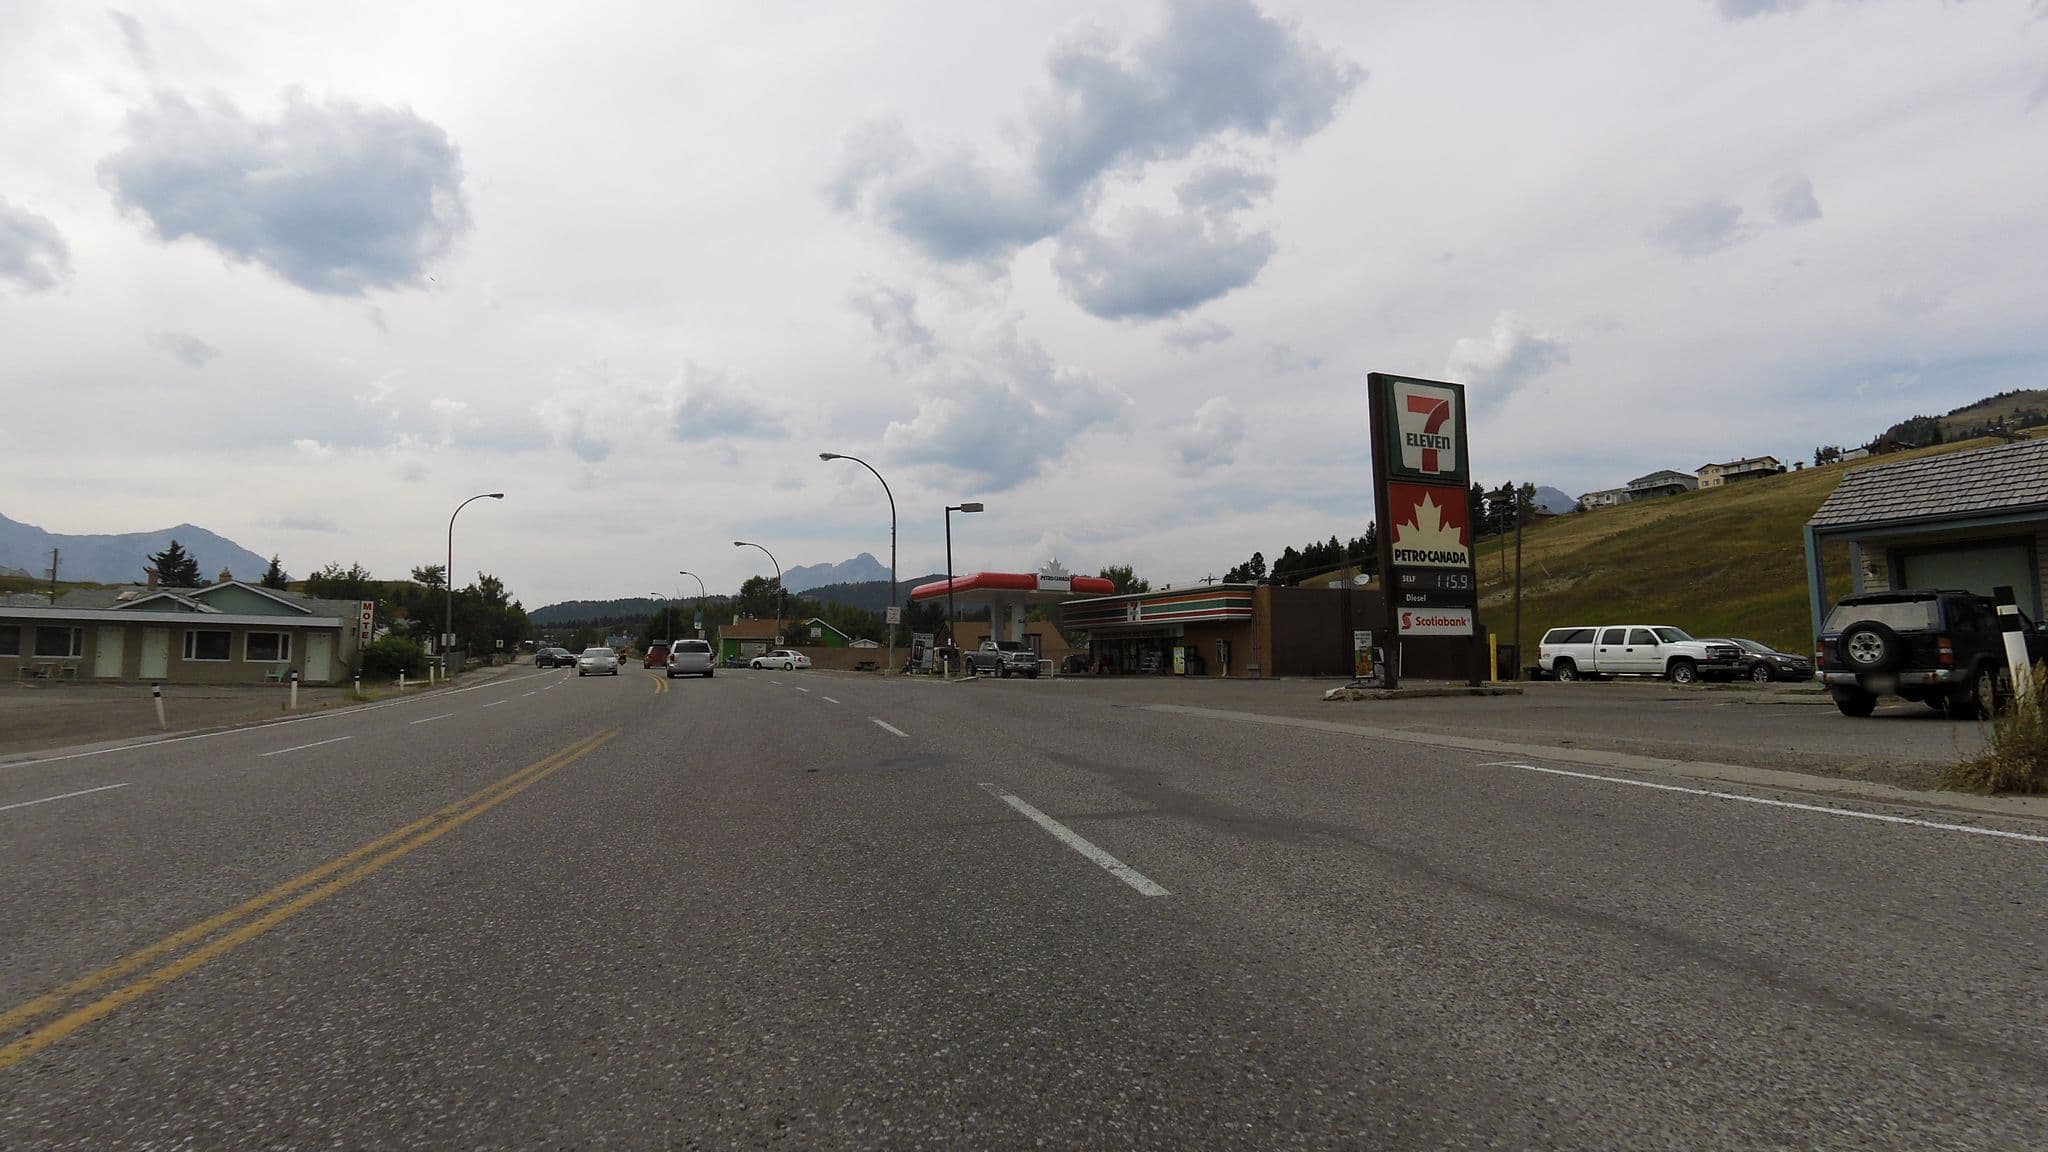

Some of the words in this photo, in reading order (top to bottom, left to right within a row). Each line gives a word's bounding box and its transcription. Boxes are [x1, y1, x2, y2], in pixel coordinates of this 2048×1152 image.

[1407, 394, 1449, 472] 7
[1406, 432, 1450, 450] ELEVEN
[1402, 575, 1416, 583] SELF
[1406, 593, 1427, 602] Diesel
[1416, 616, 1467, 627] Scotiabank
